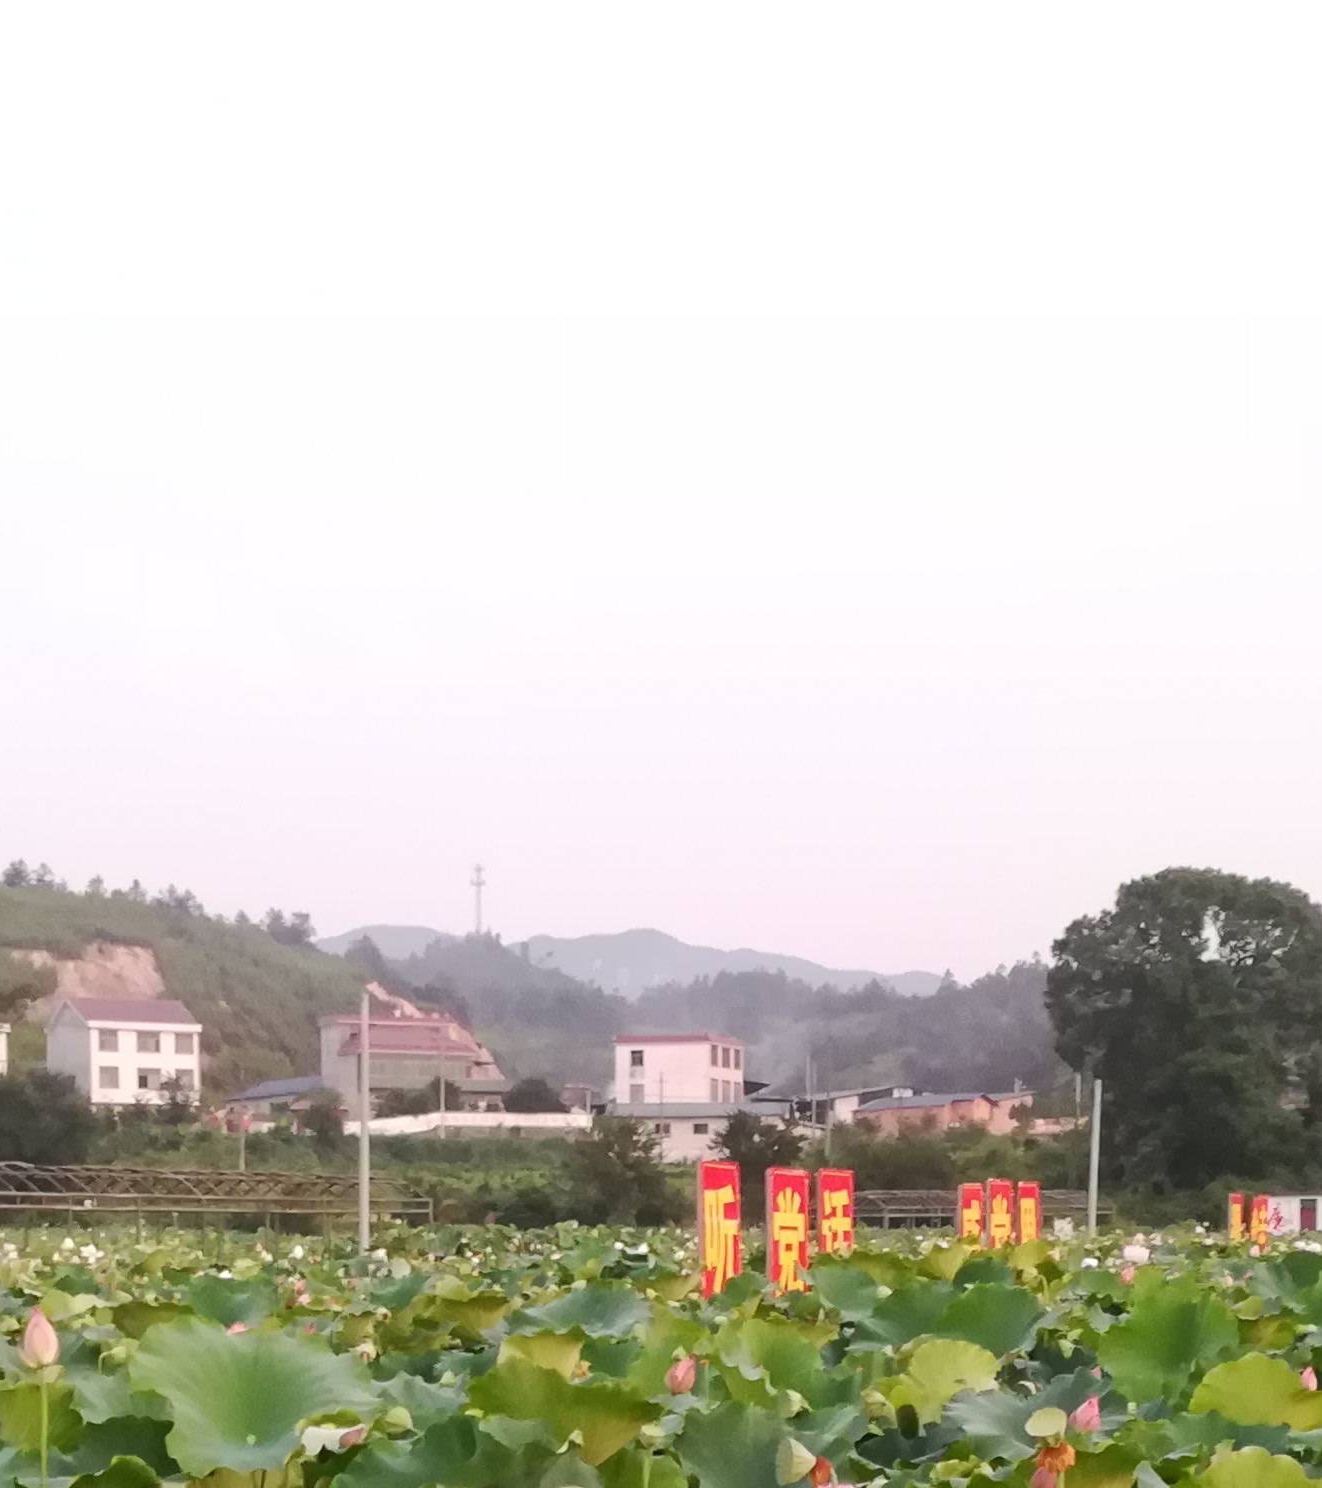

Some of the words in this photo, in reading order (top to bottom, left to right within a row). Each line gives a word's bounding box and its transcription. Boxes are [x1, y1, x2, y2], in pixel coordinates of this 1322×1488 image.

[703, 1184, 740, 1293] 听
[772, 1186, 806, 1297] 党
[821, 1189, 852, 1253] 话
[989, 1192, 1012, 1248] 党
